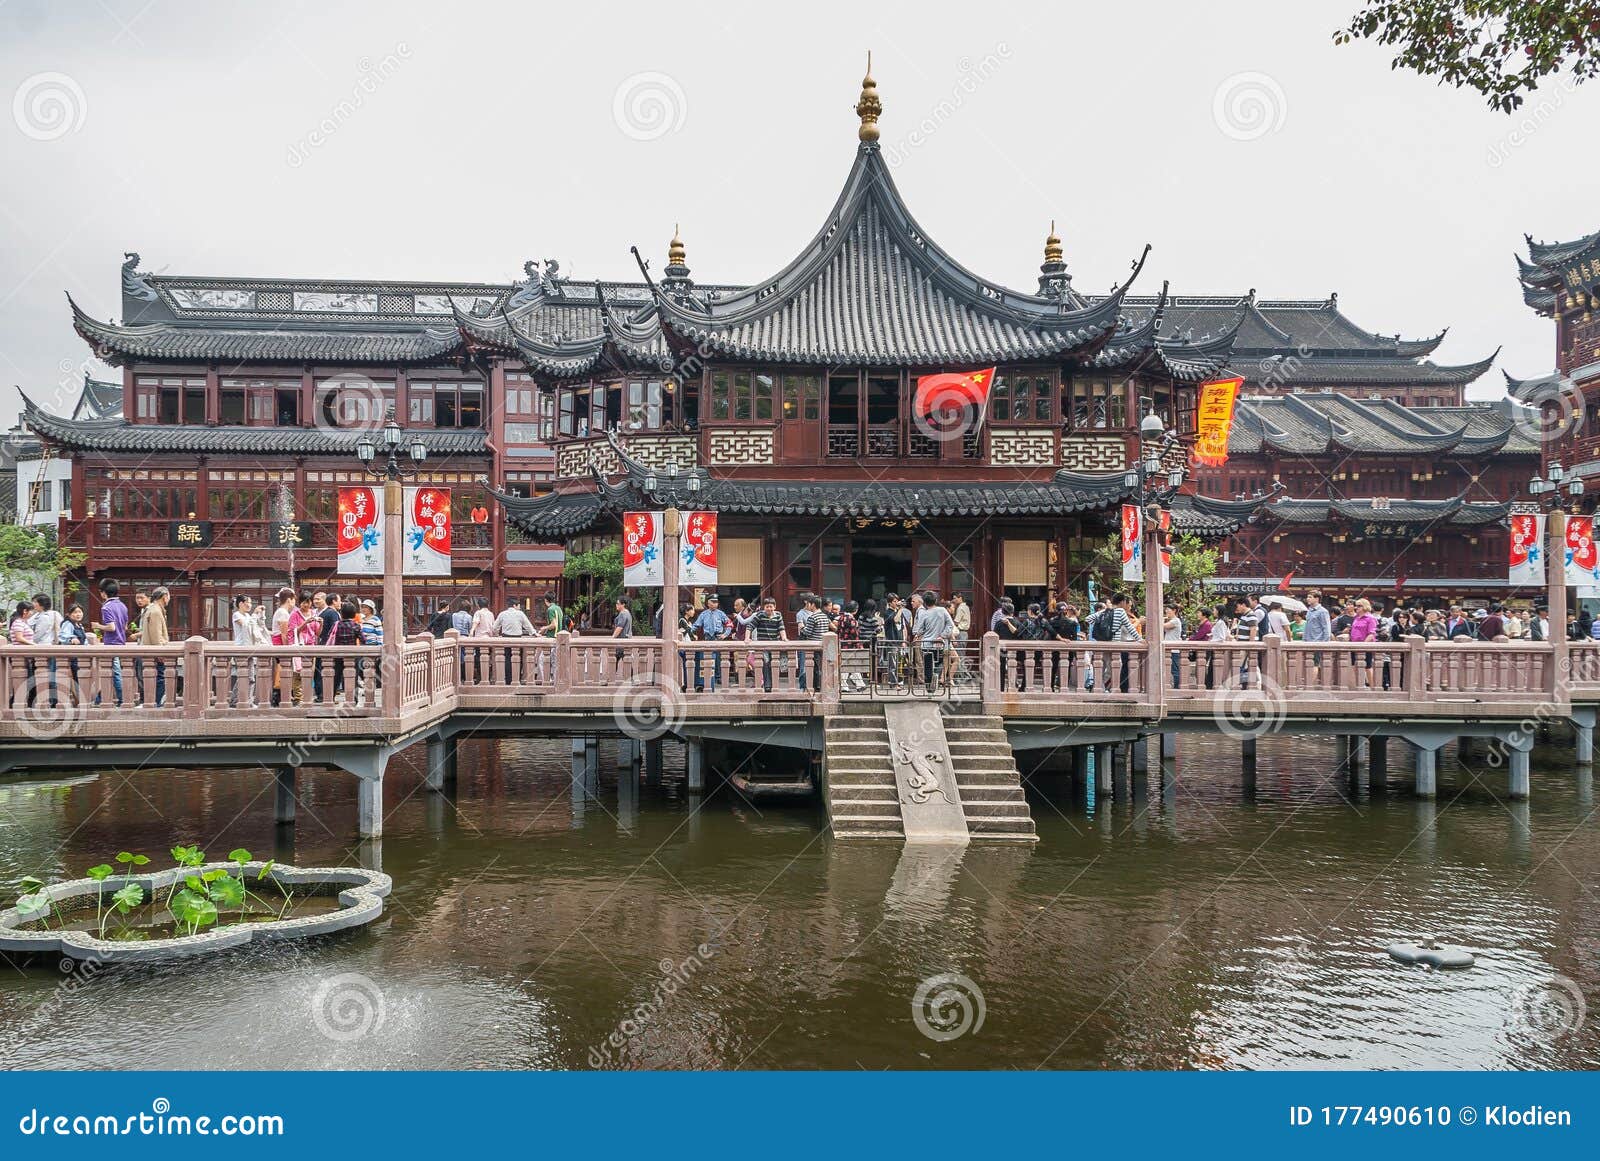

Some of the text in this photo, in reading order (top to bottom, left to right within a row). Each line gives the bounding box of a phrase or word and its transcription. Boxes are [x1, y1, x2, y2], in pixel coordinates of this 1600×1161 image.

[353, 491, 369, 519] 共享
[419, 492, 435, 518] 体验
[278, 523, 303, 544] 波
[1241, 585, 1277, 593] COFFEE
